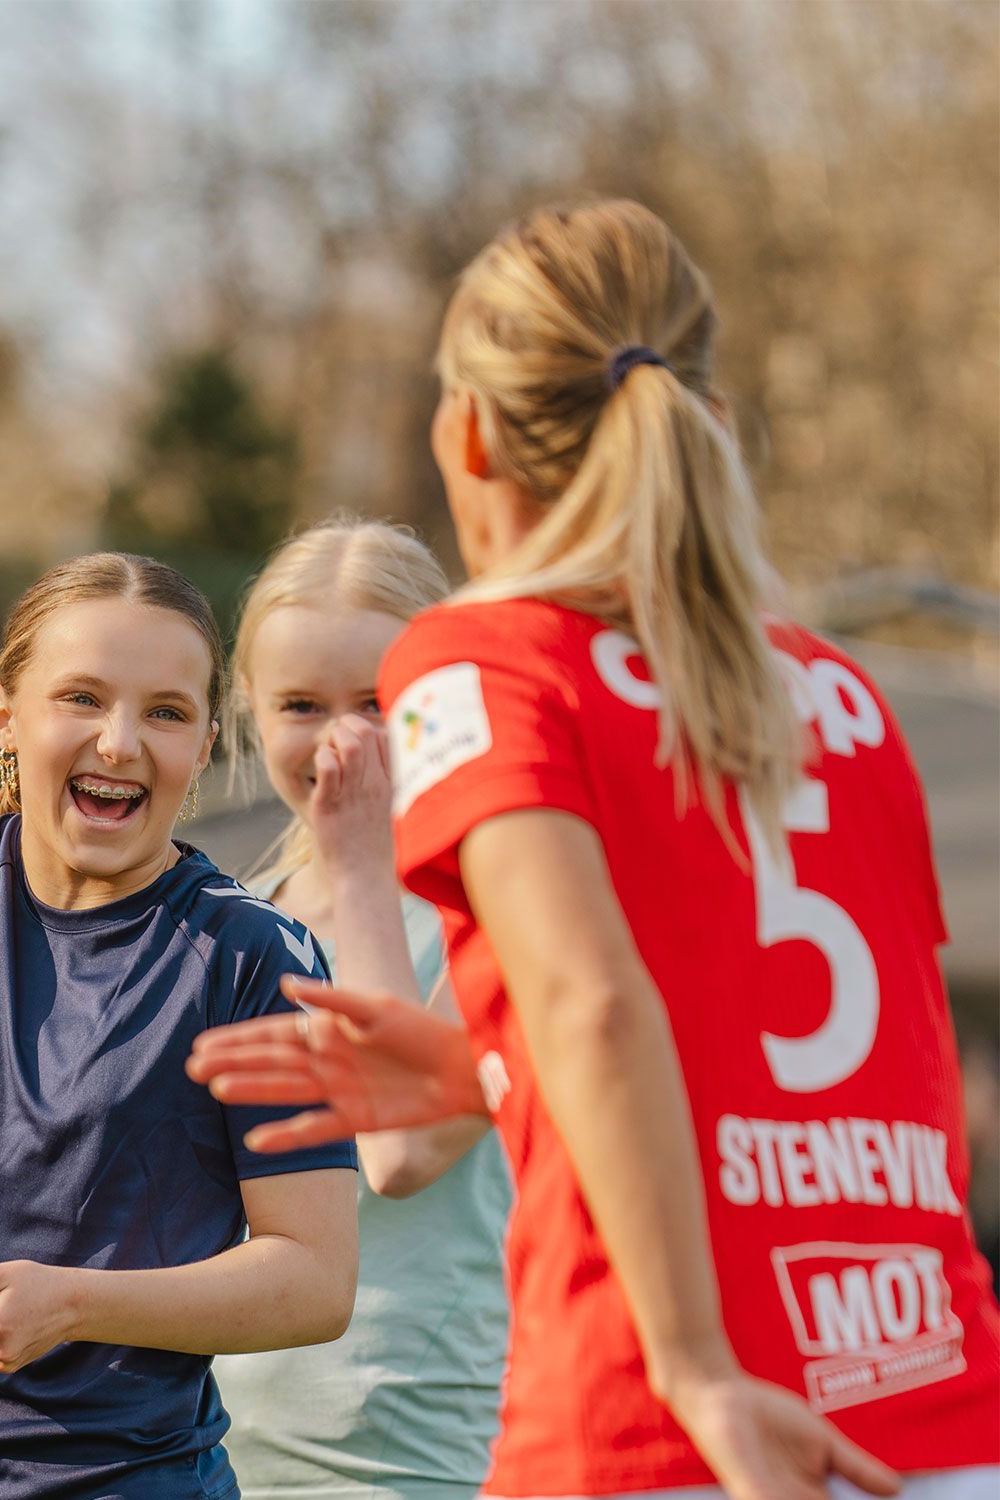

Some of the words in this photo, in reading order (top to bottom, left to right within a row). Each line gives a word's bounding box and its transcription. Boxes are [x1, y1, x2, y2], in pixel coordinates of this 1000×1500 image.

[738, 778, 881, 1093] 5
[716, 1113, 962, 1217] STENEVIK
[808, 1250, 944, 1351] MOT
